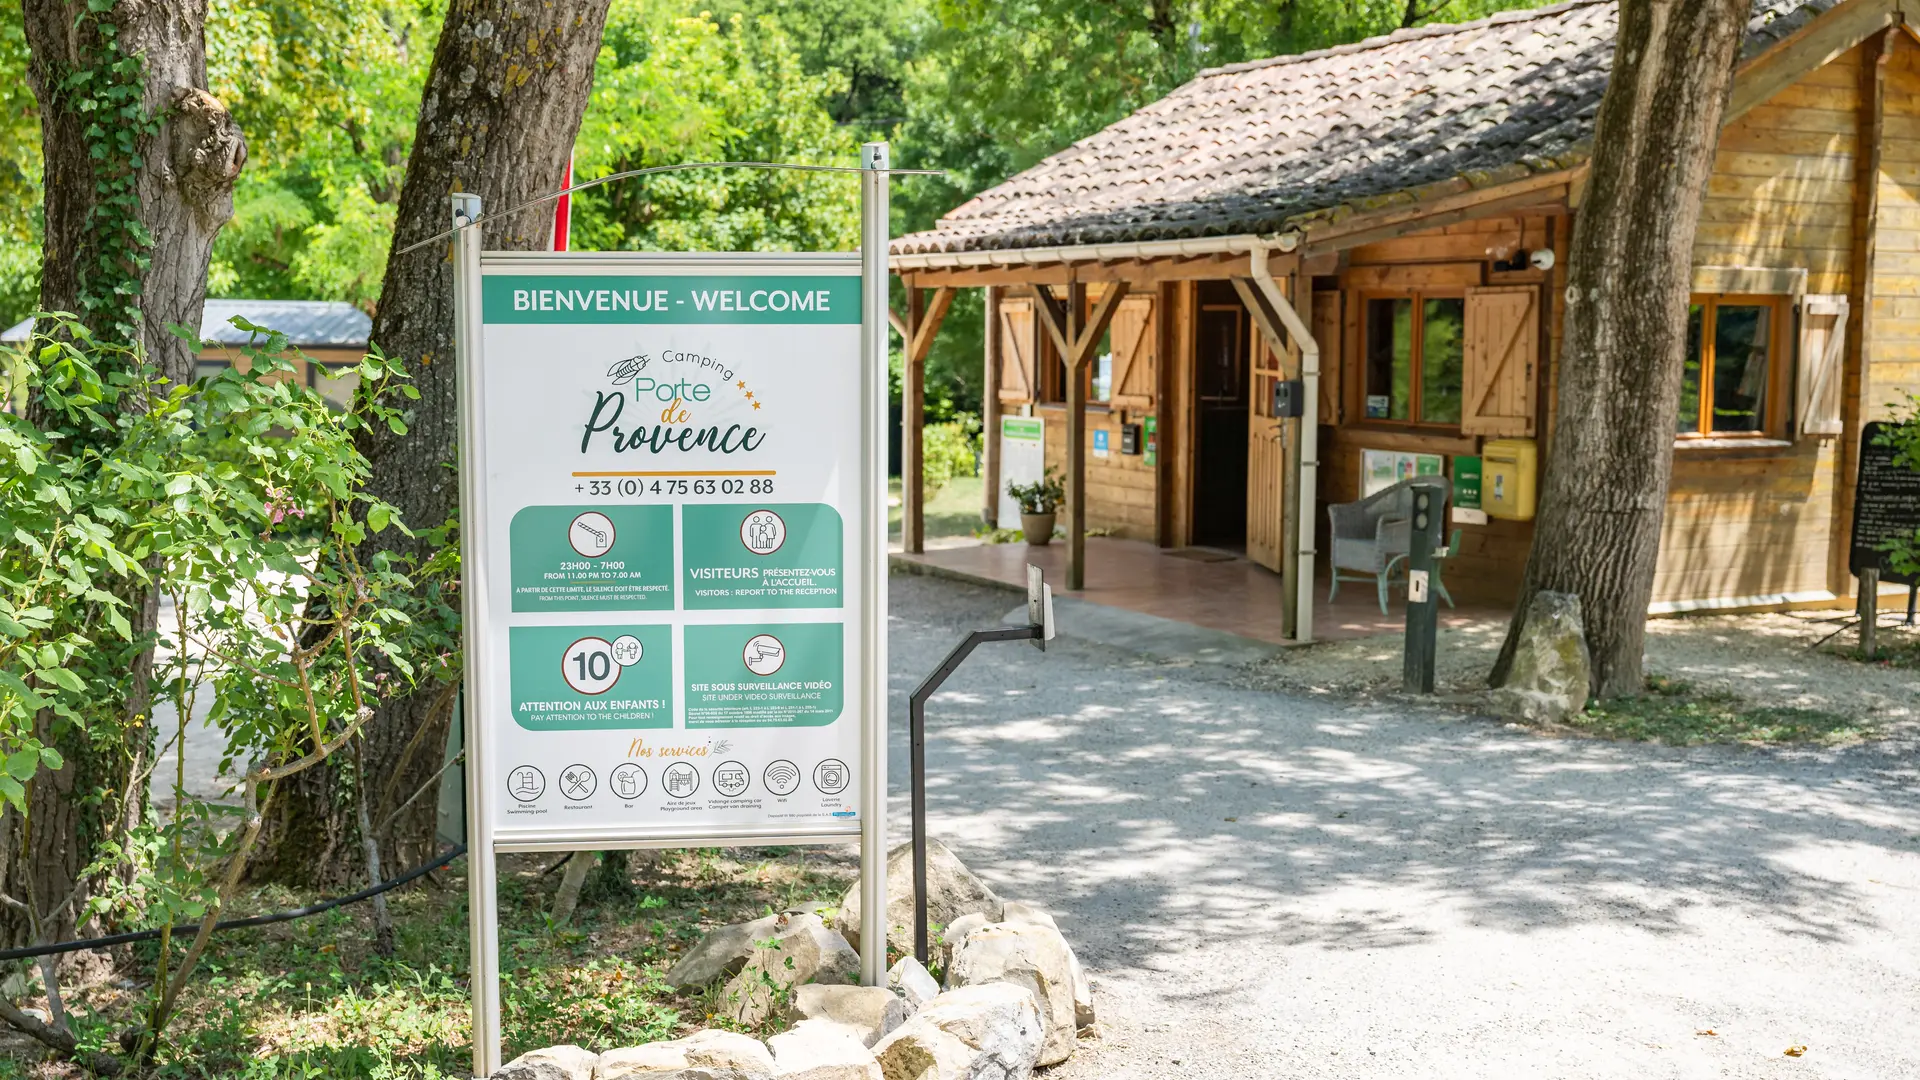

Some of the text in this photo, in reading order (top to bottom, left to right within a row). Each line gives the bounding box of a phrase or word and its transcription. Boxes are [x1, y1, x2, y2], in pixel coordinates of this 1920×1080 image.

[513, 290, 668, 311] BIENVENUE
[692, 290, 830, 311] WELCOME
[662, 350, 734, 382] Camping
[636, 378, 711, 402] Porte
[661, 397, 692, 424] de
[581, 391, 766, 453] Provence
[575, 478, 774, 497] + 33 (0) 4 75 63 02 88
[560, 562, 590, 570] 23H00
[600, 562, 625, 570] 7H00
[629, 571, 641, 579] AM
[690, 567, 836, 579] VISITEURS PRÉSENTEZ-VOUS
[762, 577, 769, 586] À
[573, 651, 610, 681] 10
[691, 680, 832, 692] SITE SOUS SURVEILLANCE VIDÉO
[519, 701, 581, 711] ATTENTION
[584, 701, 607, 710] AUX
[610, 700, 659, 710] ENFANTS
[744, 693, 768, 701] VIDEO
[627, 737, 708, 758] Nos services
